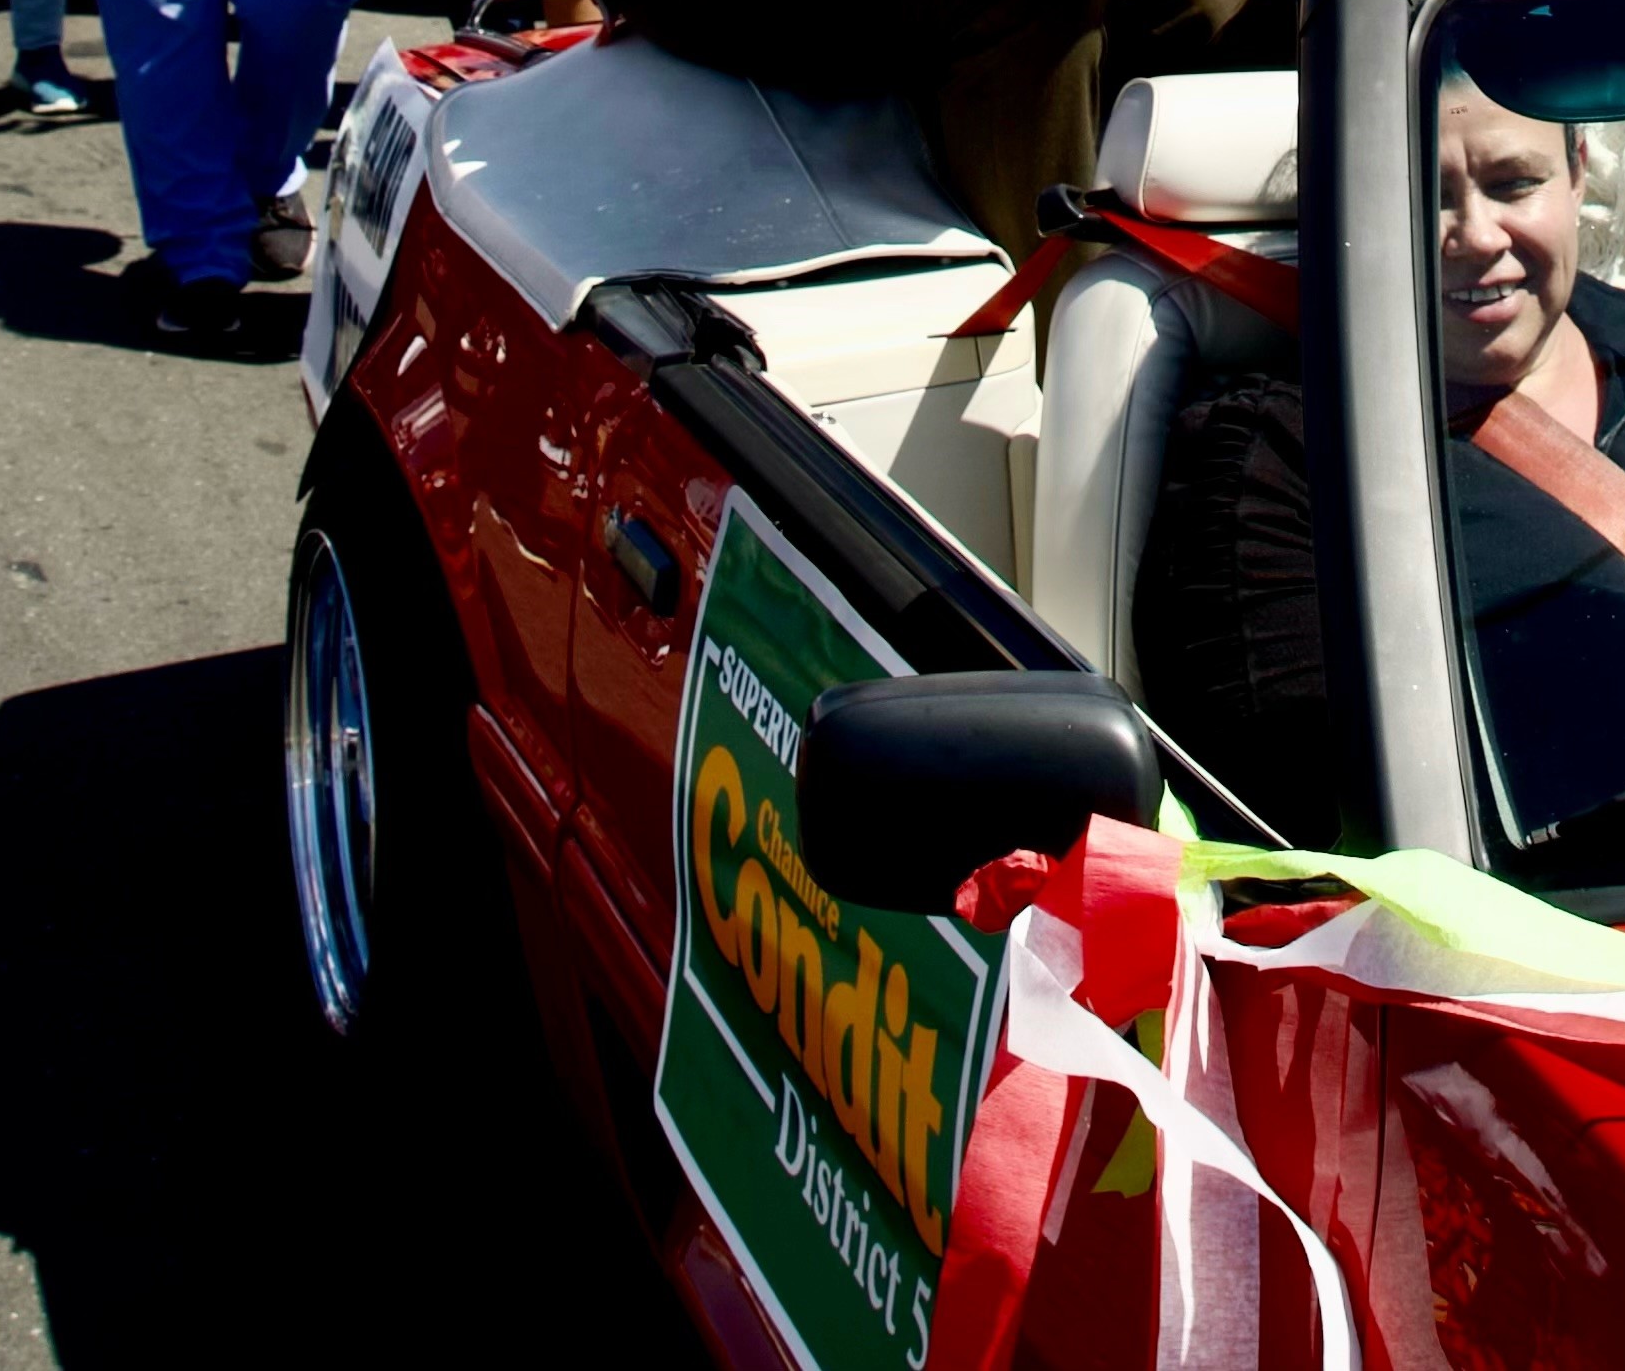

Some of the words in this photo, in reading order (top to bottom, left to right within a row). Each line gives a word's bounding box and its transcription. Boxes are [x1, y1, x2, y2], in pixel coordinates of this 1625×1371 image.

[718, 644, 802, 779] SUPERVI
[693, 744, 943, 1259] Condit
[775, 1072, 902, 1336] District
[906, 1275, 933, 1371] 5
